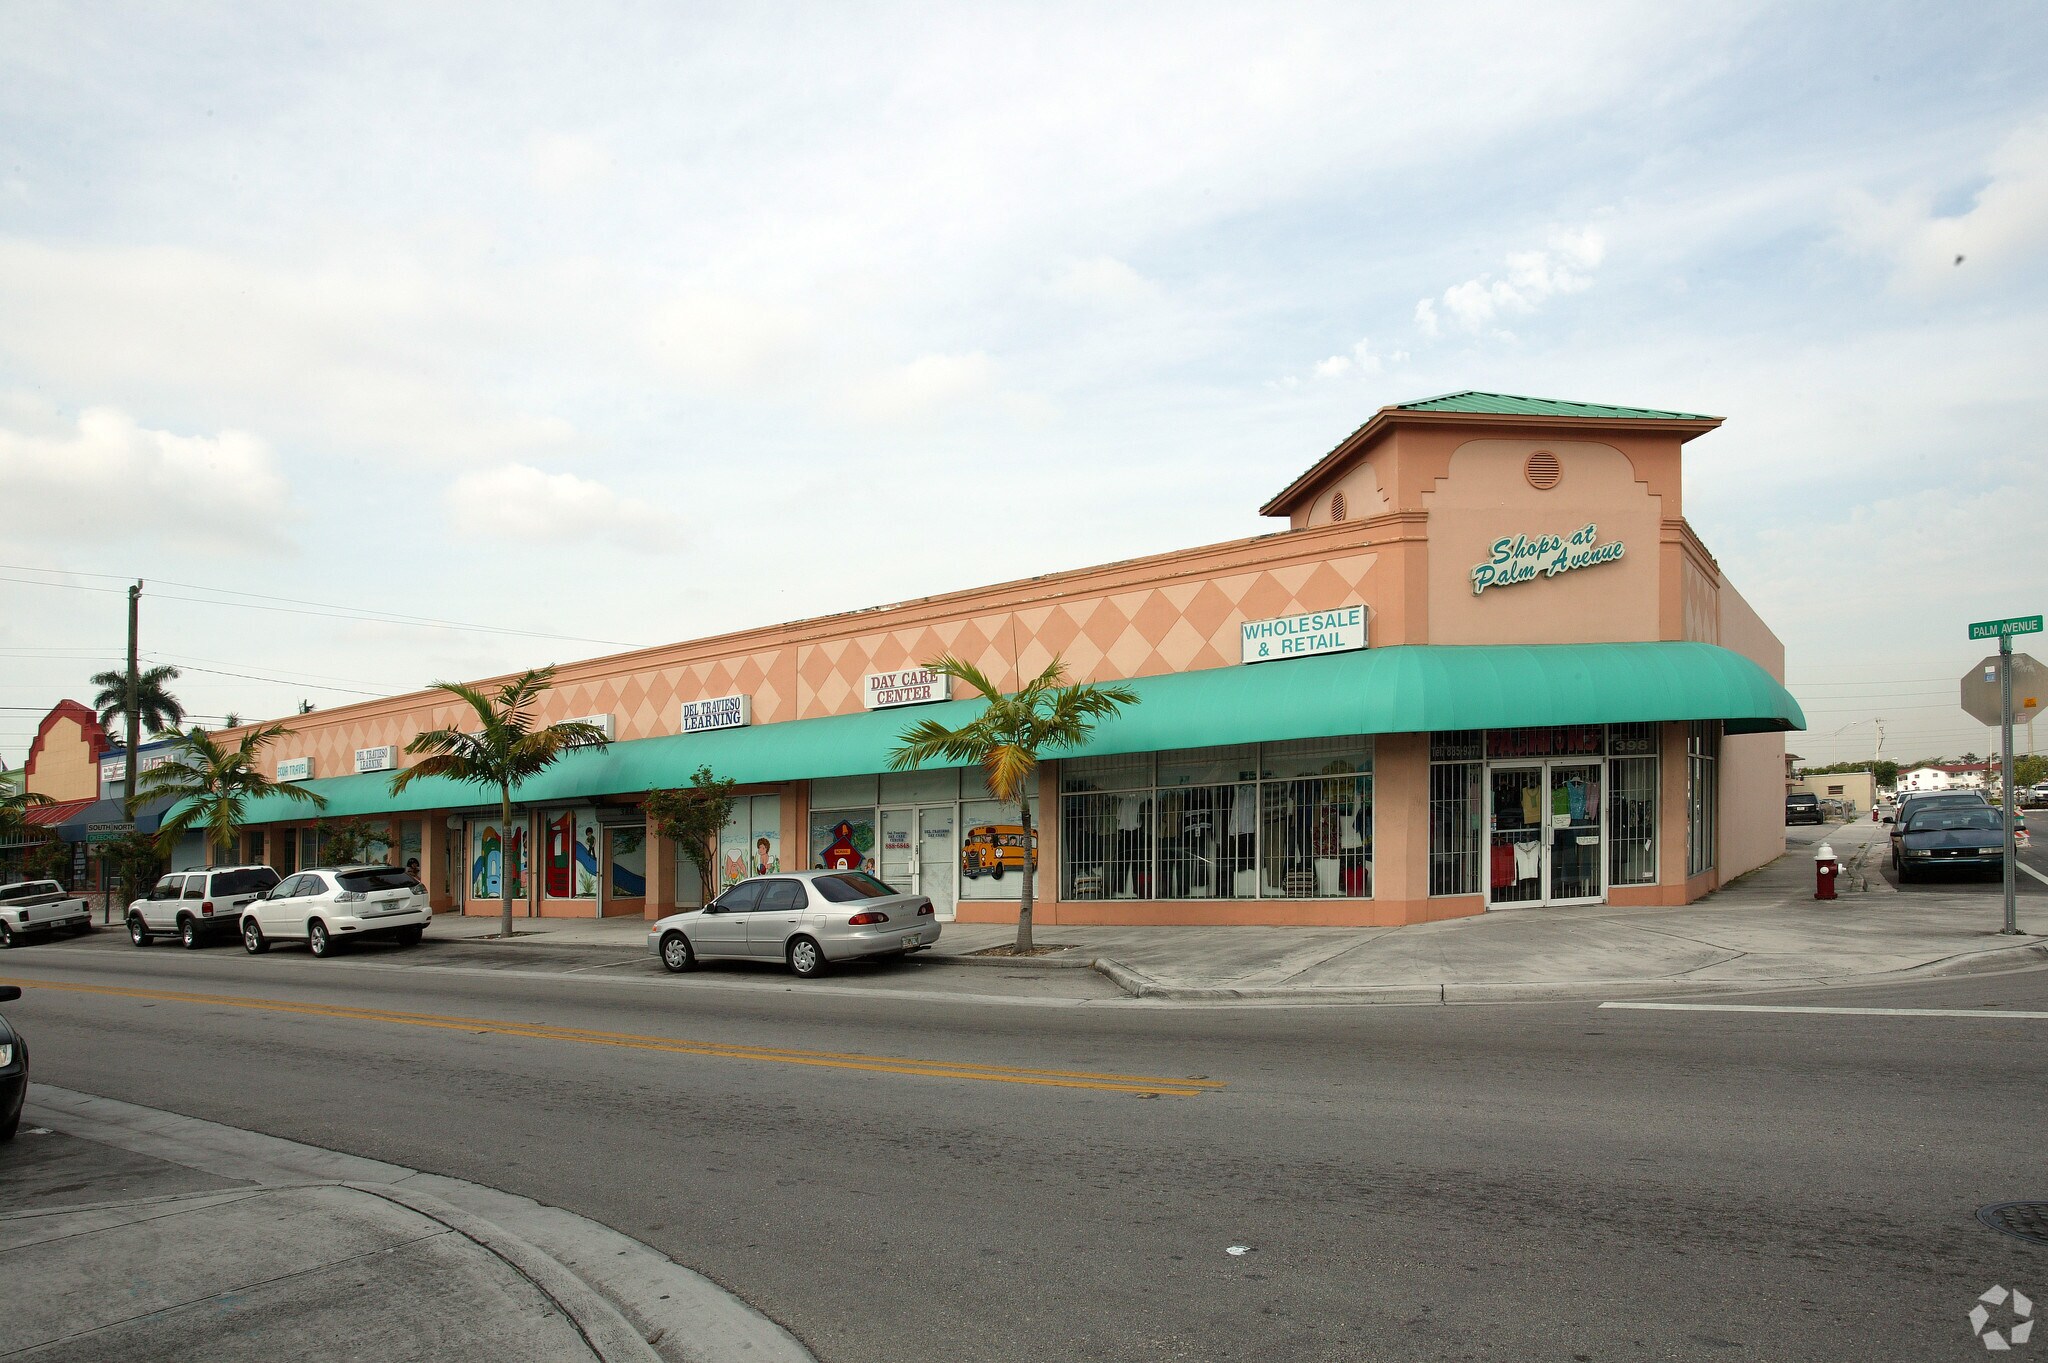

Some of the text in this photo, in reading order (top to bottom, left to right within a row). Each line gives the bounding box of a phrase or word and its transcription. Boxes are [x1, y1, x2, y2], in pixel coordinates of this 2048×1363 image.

[1493, 525, 1594, 565] Shops at
[1475, 543, 1624, 592] Palm Avenue
[1244, 609, 1360, 640] WHOLESALE
[1973, 620, 2038, 637] PALM AVENUE
[1258, 632, 1345, 657] & RETAIL
[871, 669, 938, 690] DAY CARE
[877, 685, 932, 704] CENTER
[684, 697, 741, 718] DEL TRAVIESO
[684, 711, 741, 731] LEARNING
[1615, 740, 1649, 751] 398
